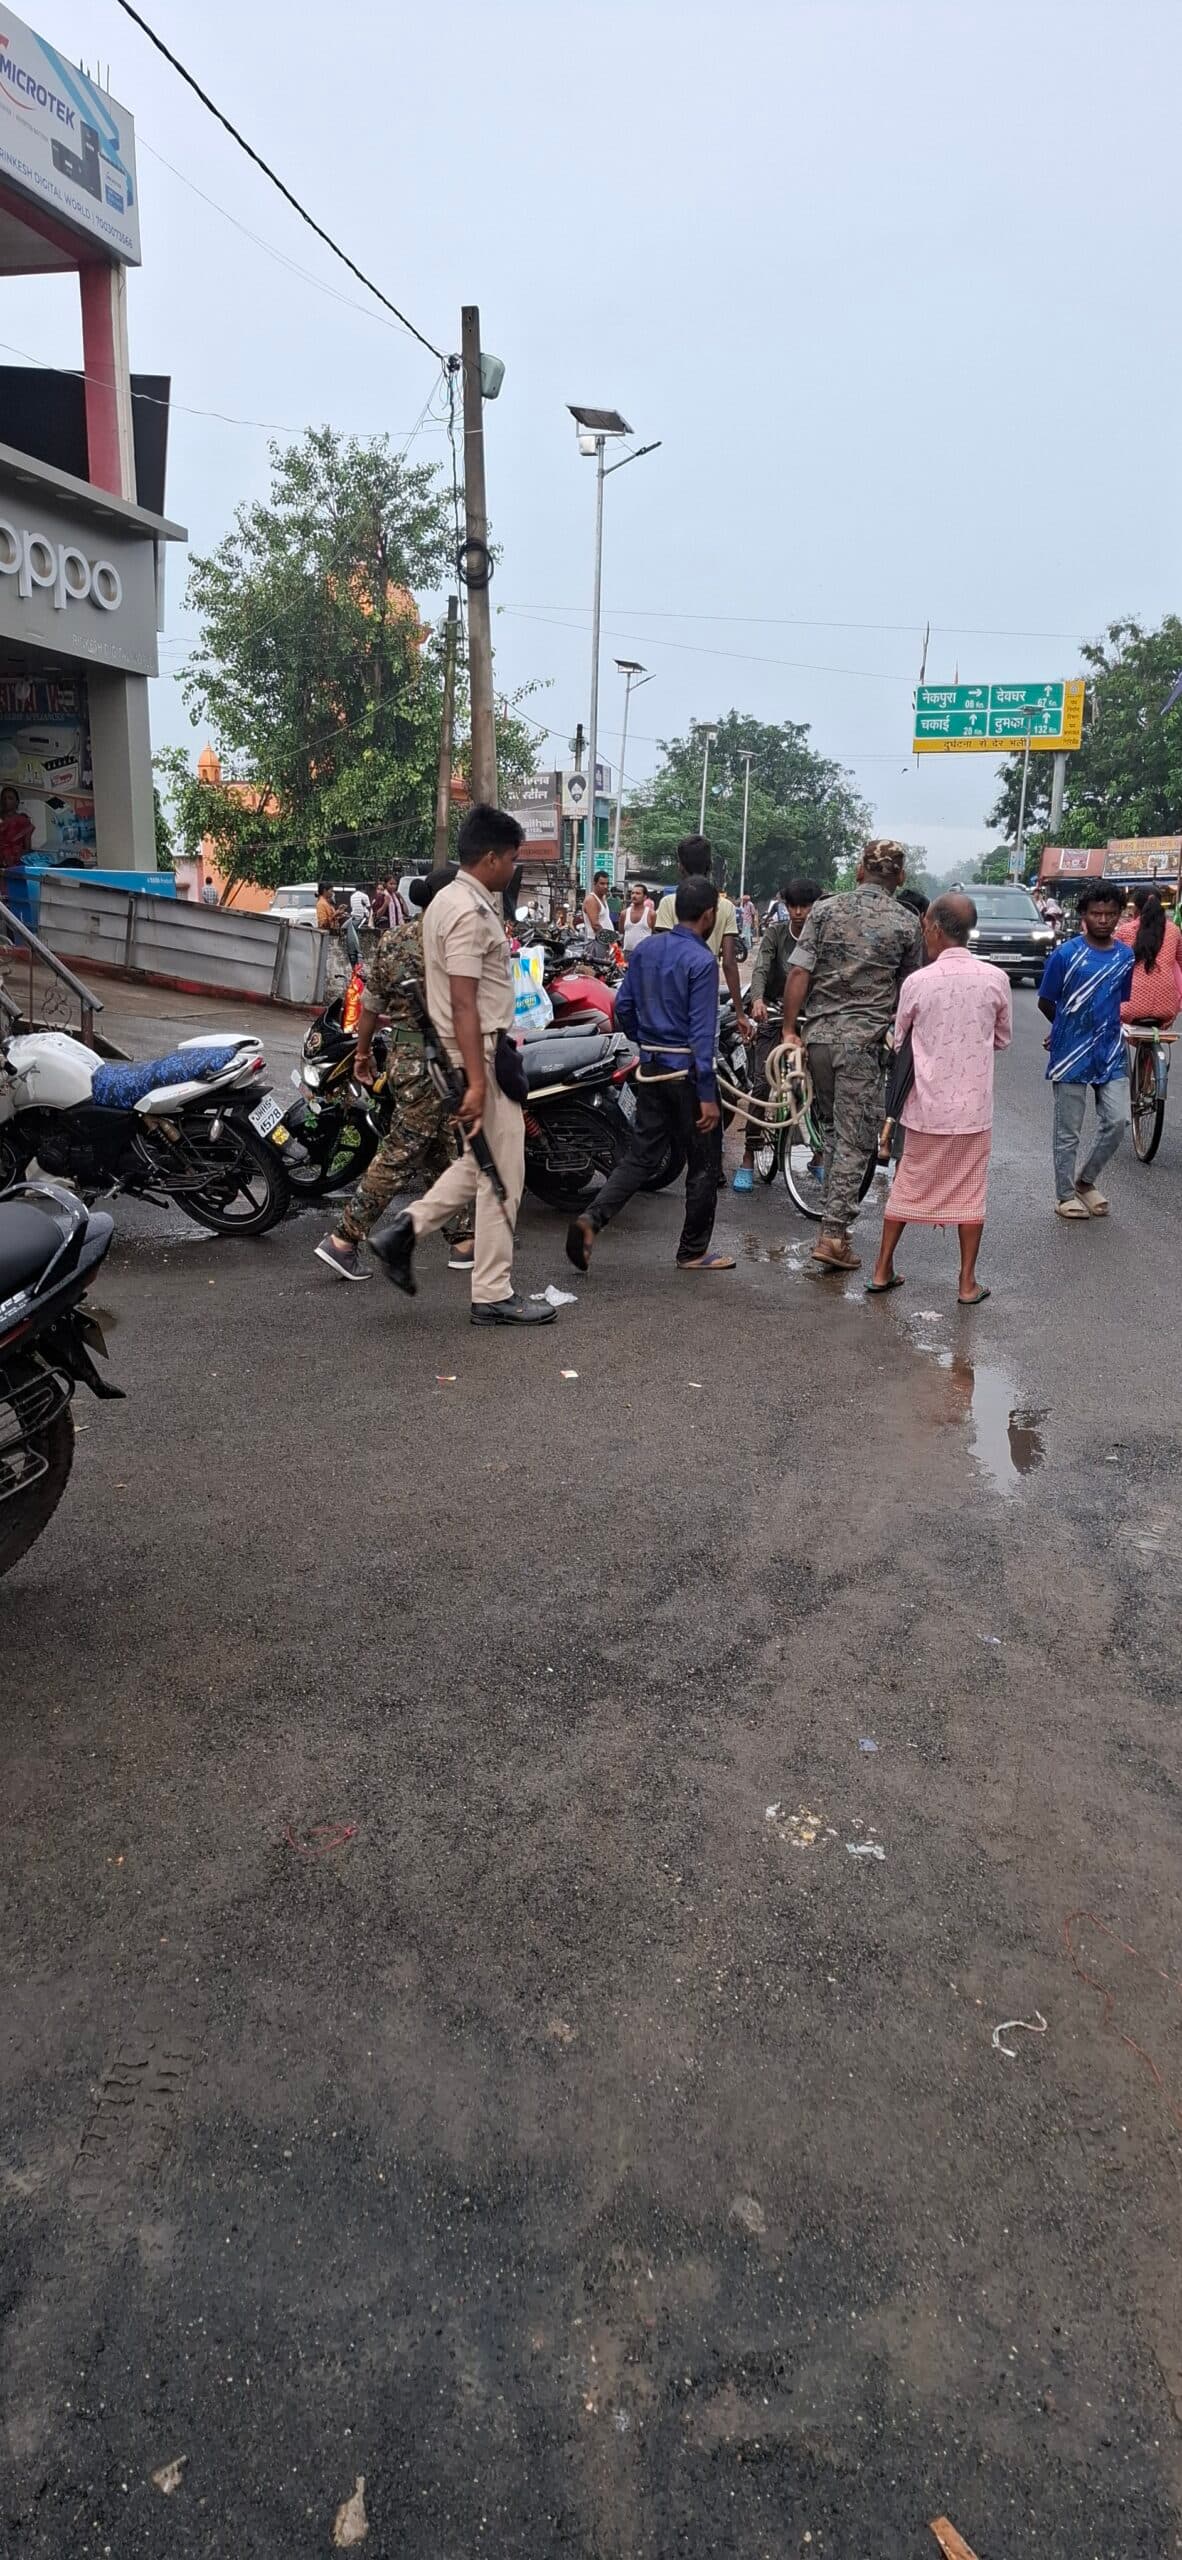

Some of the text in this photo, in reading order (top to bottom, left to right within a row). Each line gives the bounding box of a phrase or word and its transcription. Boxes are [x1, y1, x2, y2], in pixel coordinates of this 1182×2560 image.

[0, 53, 75, 130] MICROTEK
[64, 192, 91, 219] WORLD
[996, 687, 1027, 702] देवघर
[920, 715, 950, 732] चकाई
[994, 717, 1025, 734] दुमका
[1034, 725, 1048, 734] 132
[260, 1107, 282, 1134] 1578
